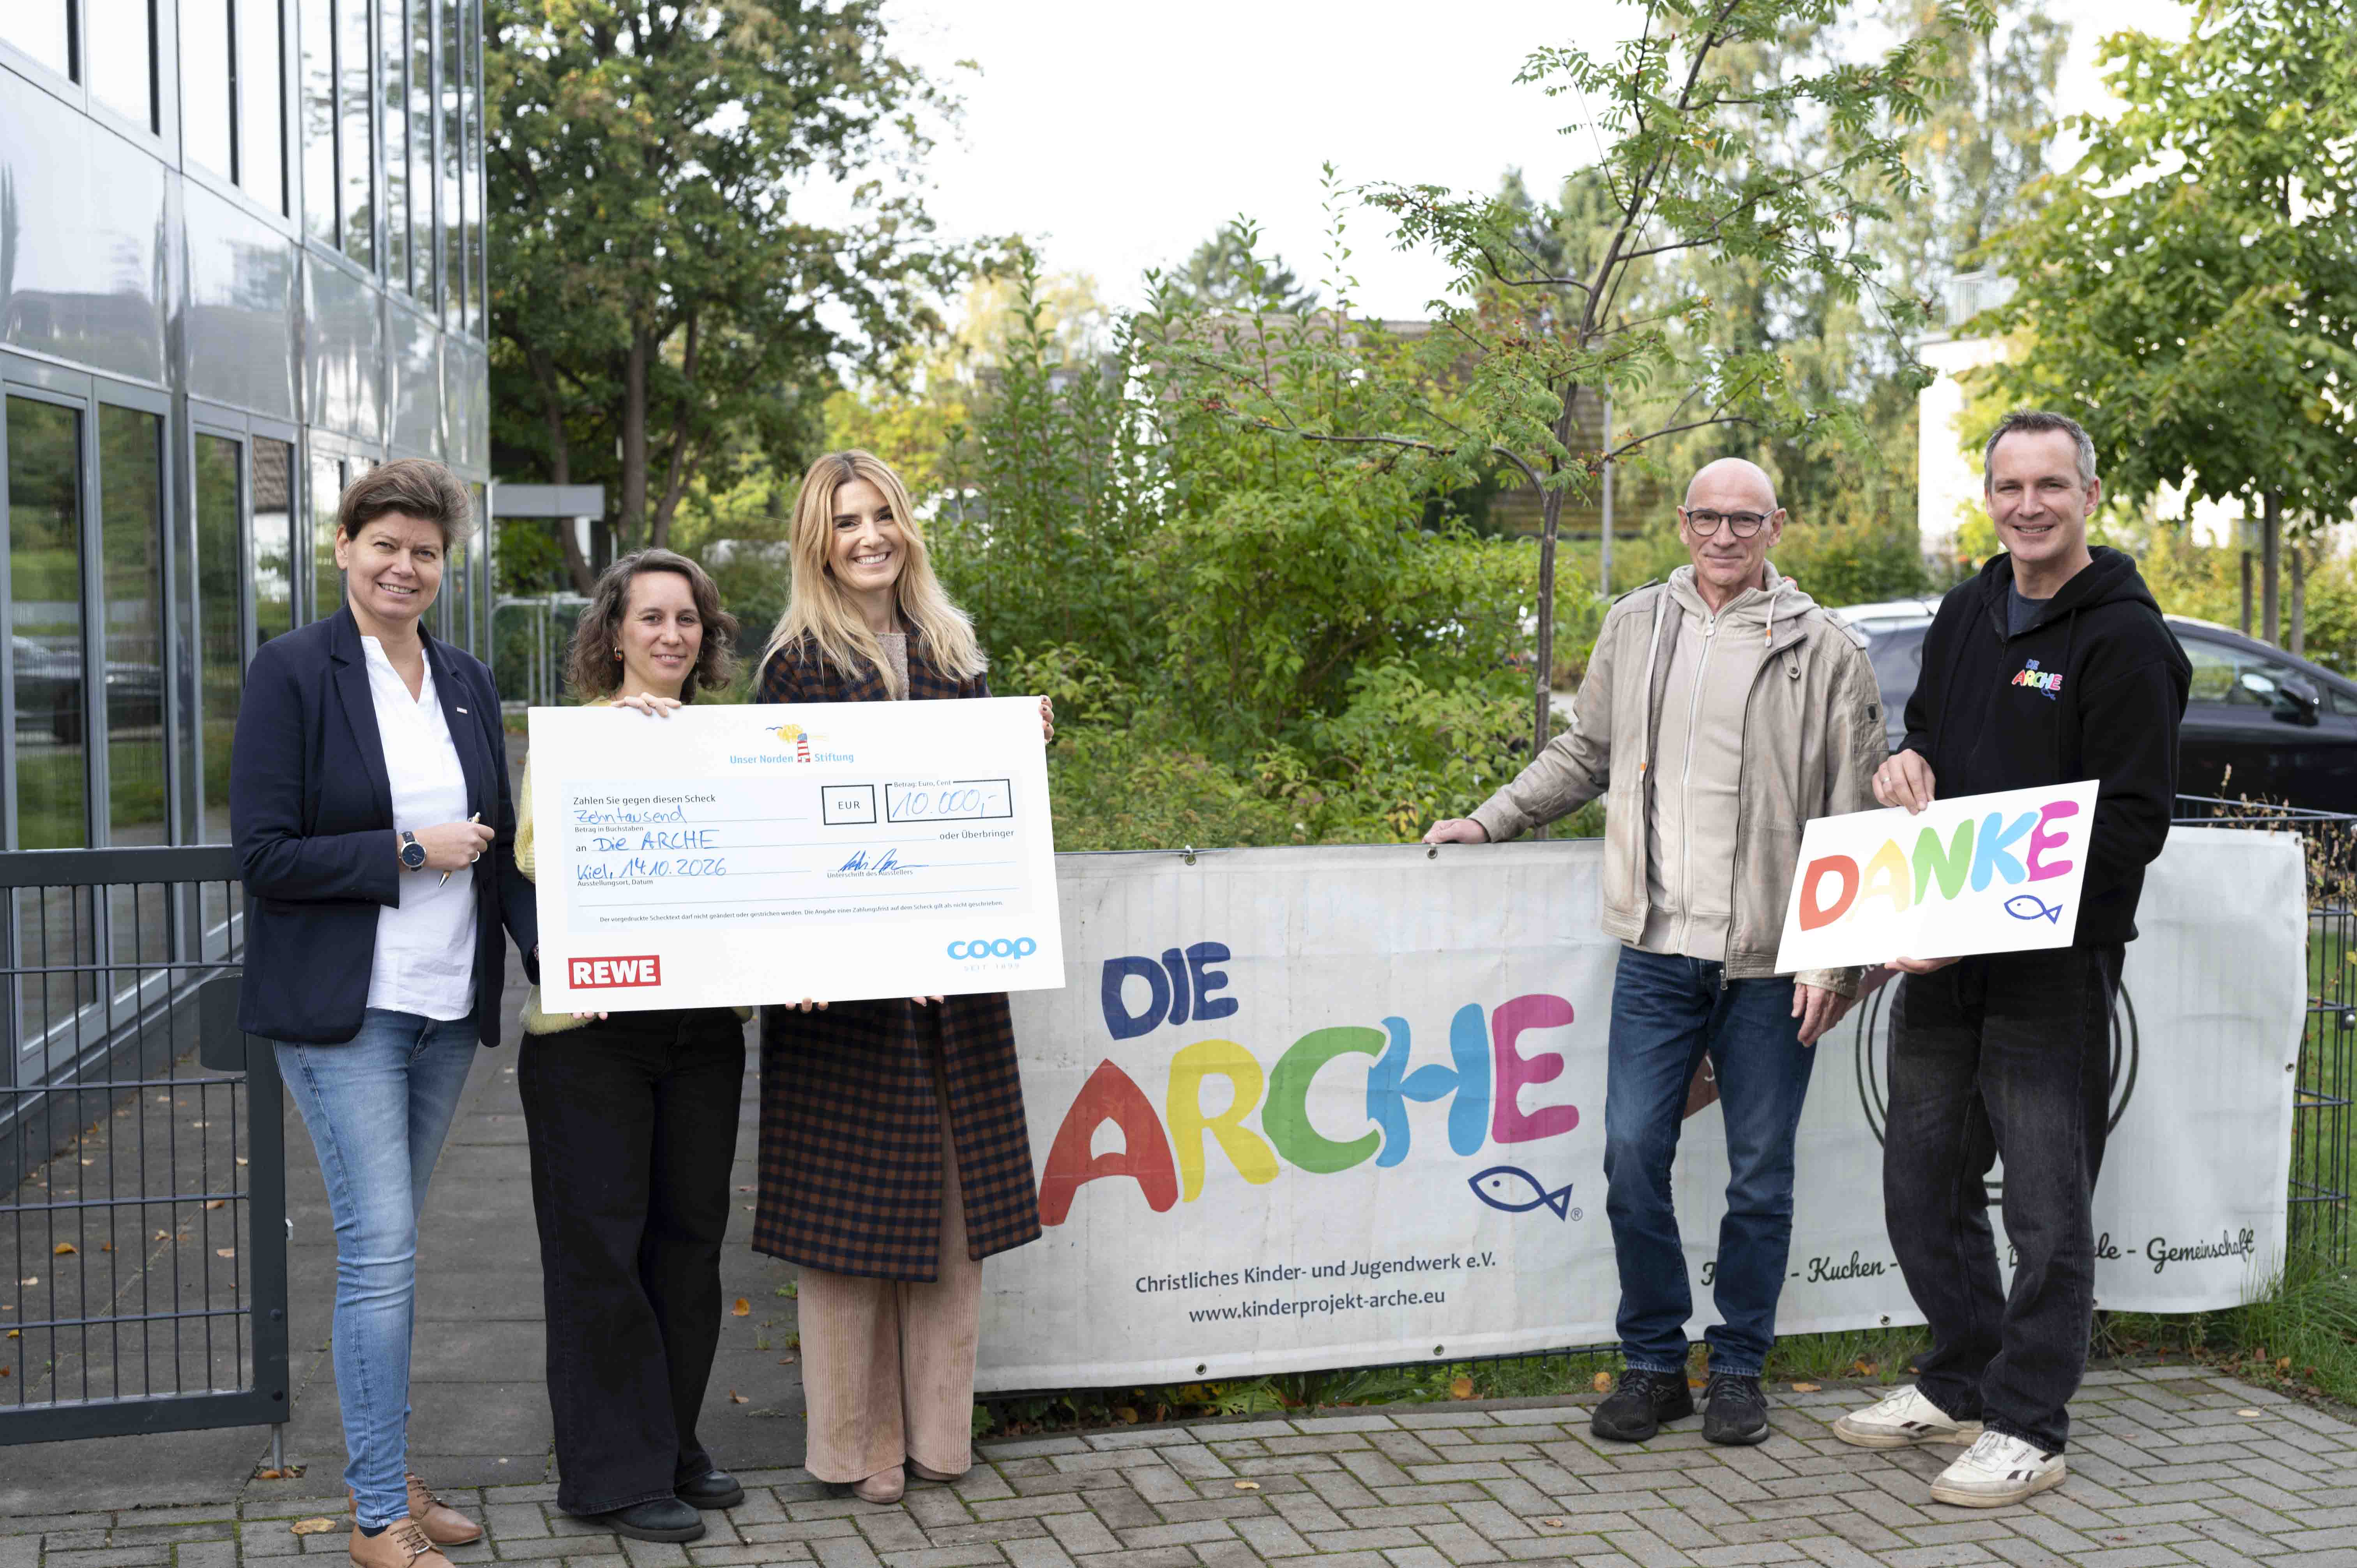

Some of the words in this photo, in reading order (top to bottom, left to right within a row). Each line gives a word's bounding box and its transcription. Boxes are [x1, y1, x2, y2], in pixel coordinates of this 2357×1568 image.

[2012, 669, 2063, 691] ARCHE
[730, 755, 757, 764] Unser
[760, 755, 793, 764] Norden
[815, 753, 854, 763] Stiftung
[574, 796, 603, 805] Zahlen
[606, 796, 620, 805] Sie
[623, 797, 650, 806] gegen
[653, 795, 682, 803] diesen
[685, 794, 716, 803] Scheck
[838, 801, 860, 810] EUR
[641, 830, 720, 850] ARCHE
[940, 831, 959, 840] oder
[962, 829, 1014, 839] Überbringer
[578, 863, 613, 880] Kiel,
[1799, 800, 2080, 931] DANKE
[947, 937, 1036, 960] coop
[573, 959, 657, 985] REWE
[1101, 941, 1239, 1040] DIE
[1038, 994, 1580, 1227] ARCHE
[2146, 1227, 2256, 1273] Gemeinschaft
[1136, 1270, 1239, 1293] Christliches
[1244, 1264, 1307, 1284] Kinder-
[1312, 1260, 1345, 1278] und
[1351, 1253, 1461, 1279] Jugendwerk
[1466, 1252, 1496, 1268] e.V.
[1807, 1250, 1885, 1283] Kuchen
[1189, 1289, 1445, 1323] www.kinderprojekt-arche.eu
